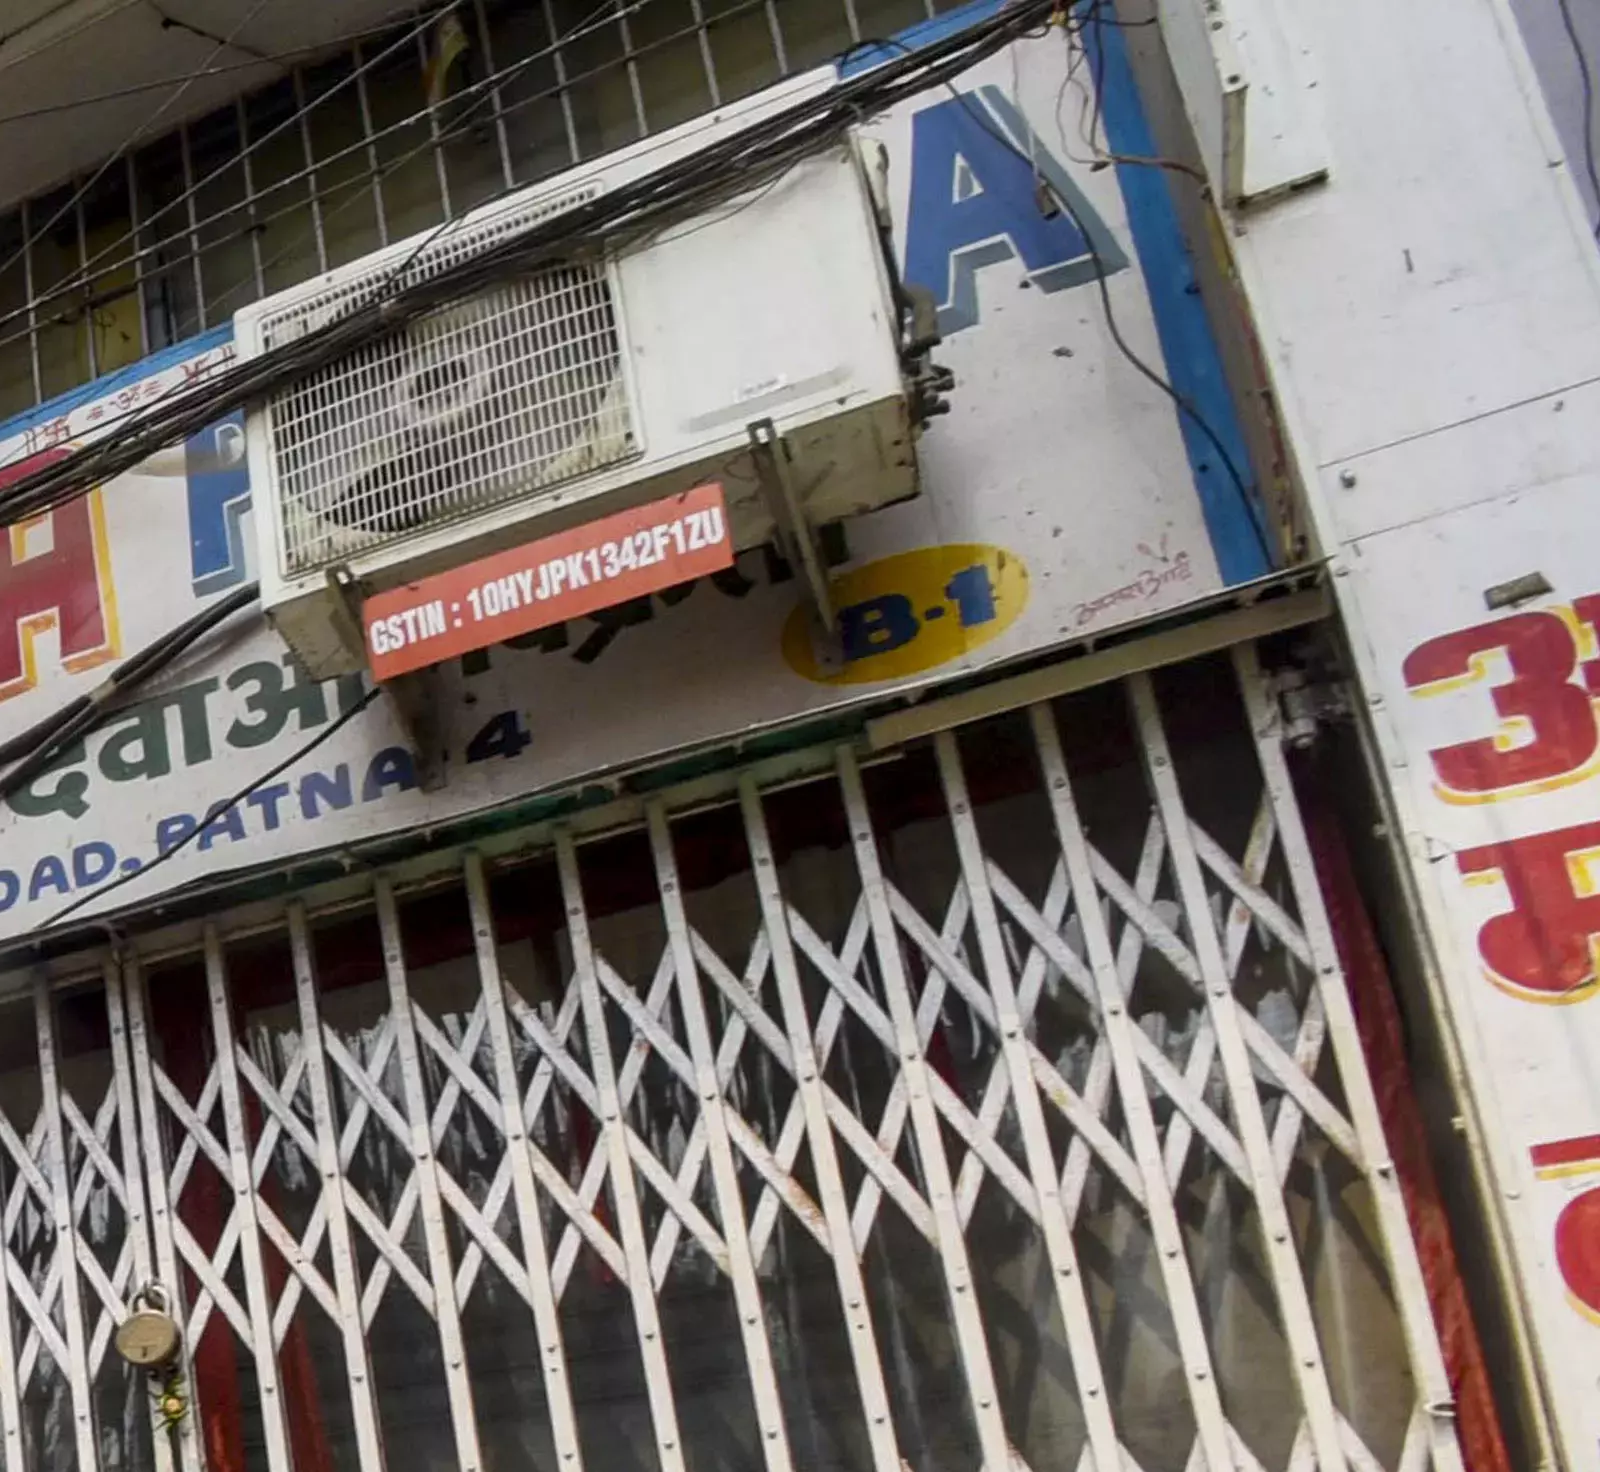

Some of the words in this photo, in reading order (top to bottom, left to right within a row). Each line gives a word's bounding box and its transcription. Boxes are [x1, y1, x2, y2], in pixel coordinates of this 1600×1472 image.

[369, 600, 446, 656] GSTIN
[466, 506, 726, 622] 10HYJPK1342F1ZU
[157, 745, 417, 860] PATNA
